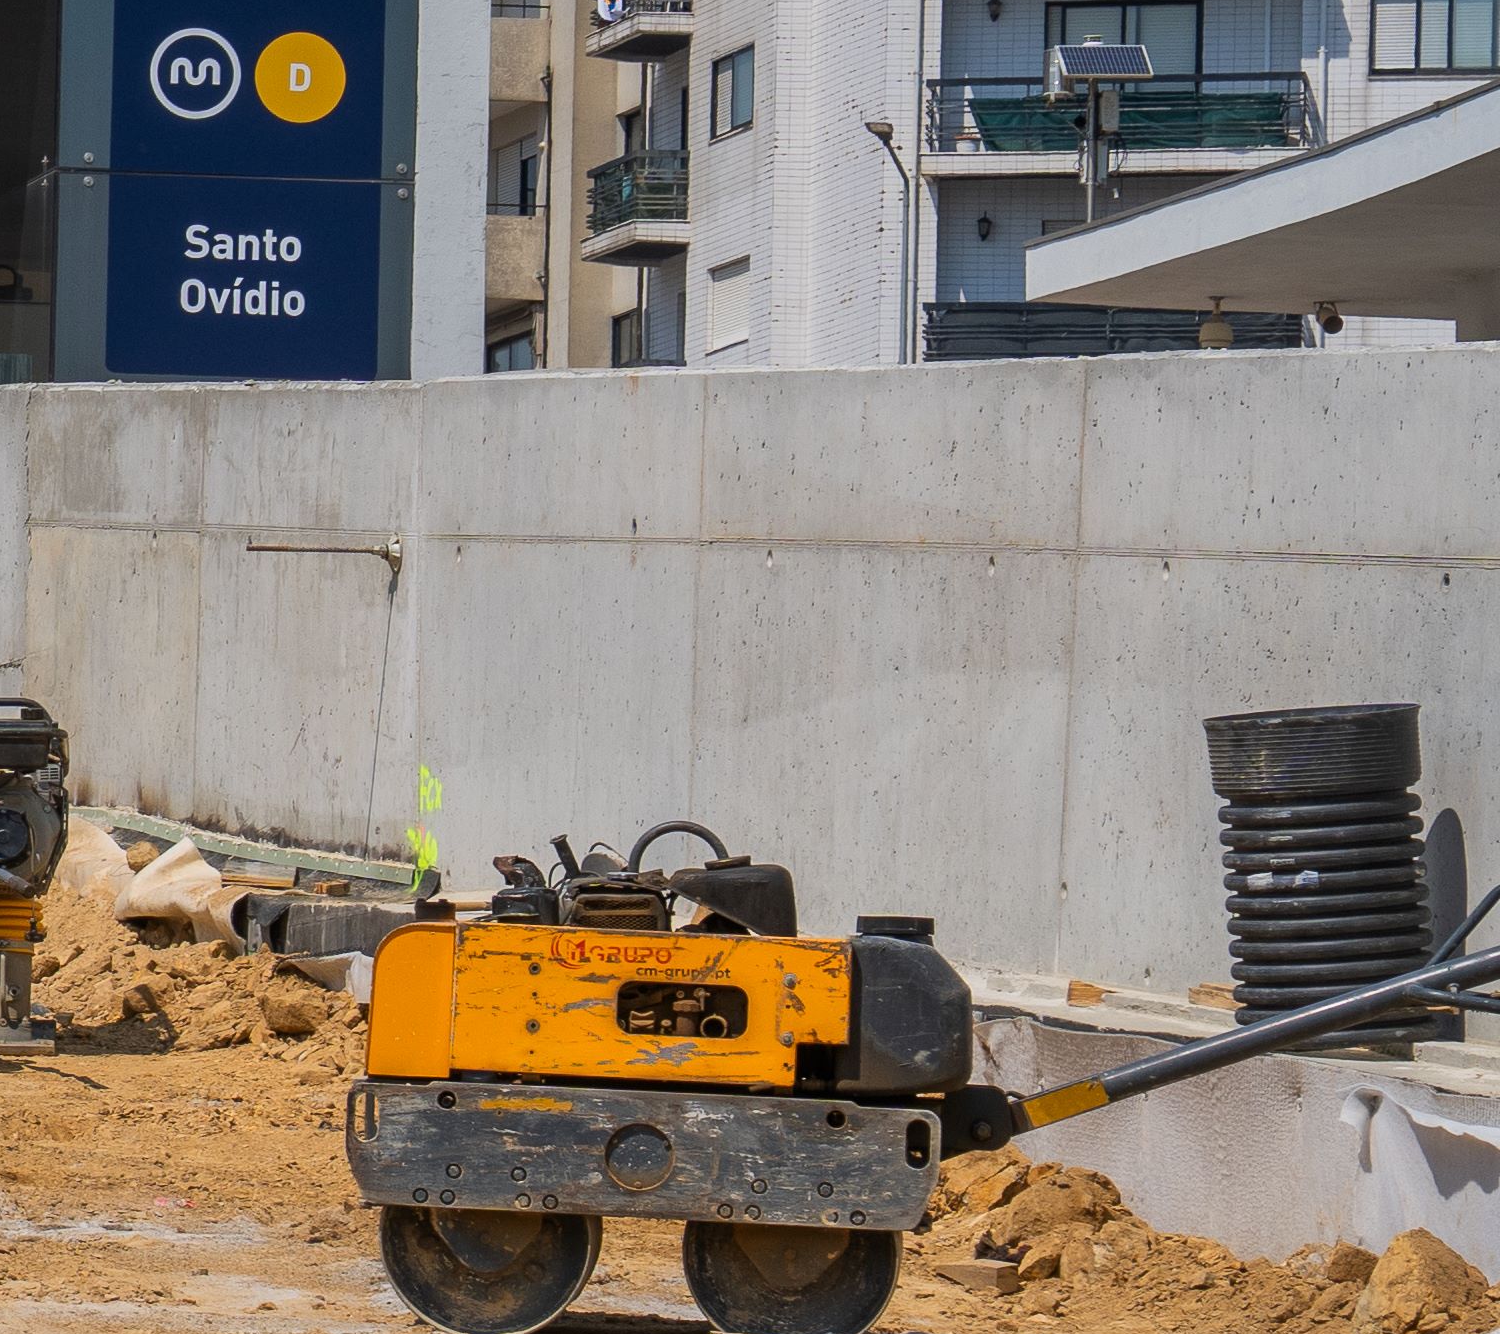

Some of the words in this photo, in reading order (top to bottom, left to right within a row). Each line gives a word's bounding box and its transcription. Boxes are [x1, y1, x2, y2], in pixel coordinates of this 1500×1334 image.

[288, 63, 311, 92] D
[184, 224, 302, 261] Santo
[180, 277, 306, 317] Ovídio
